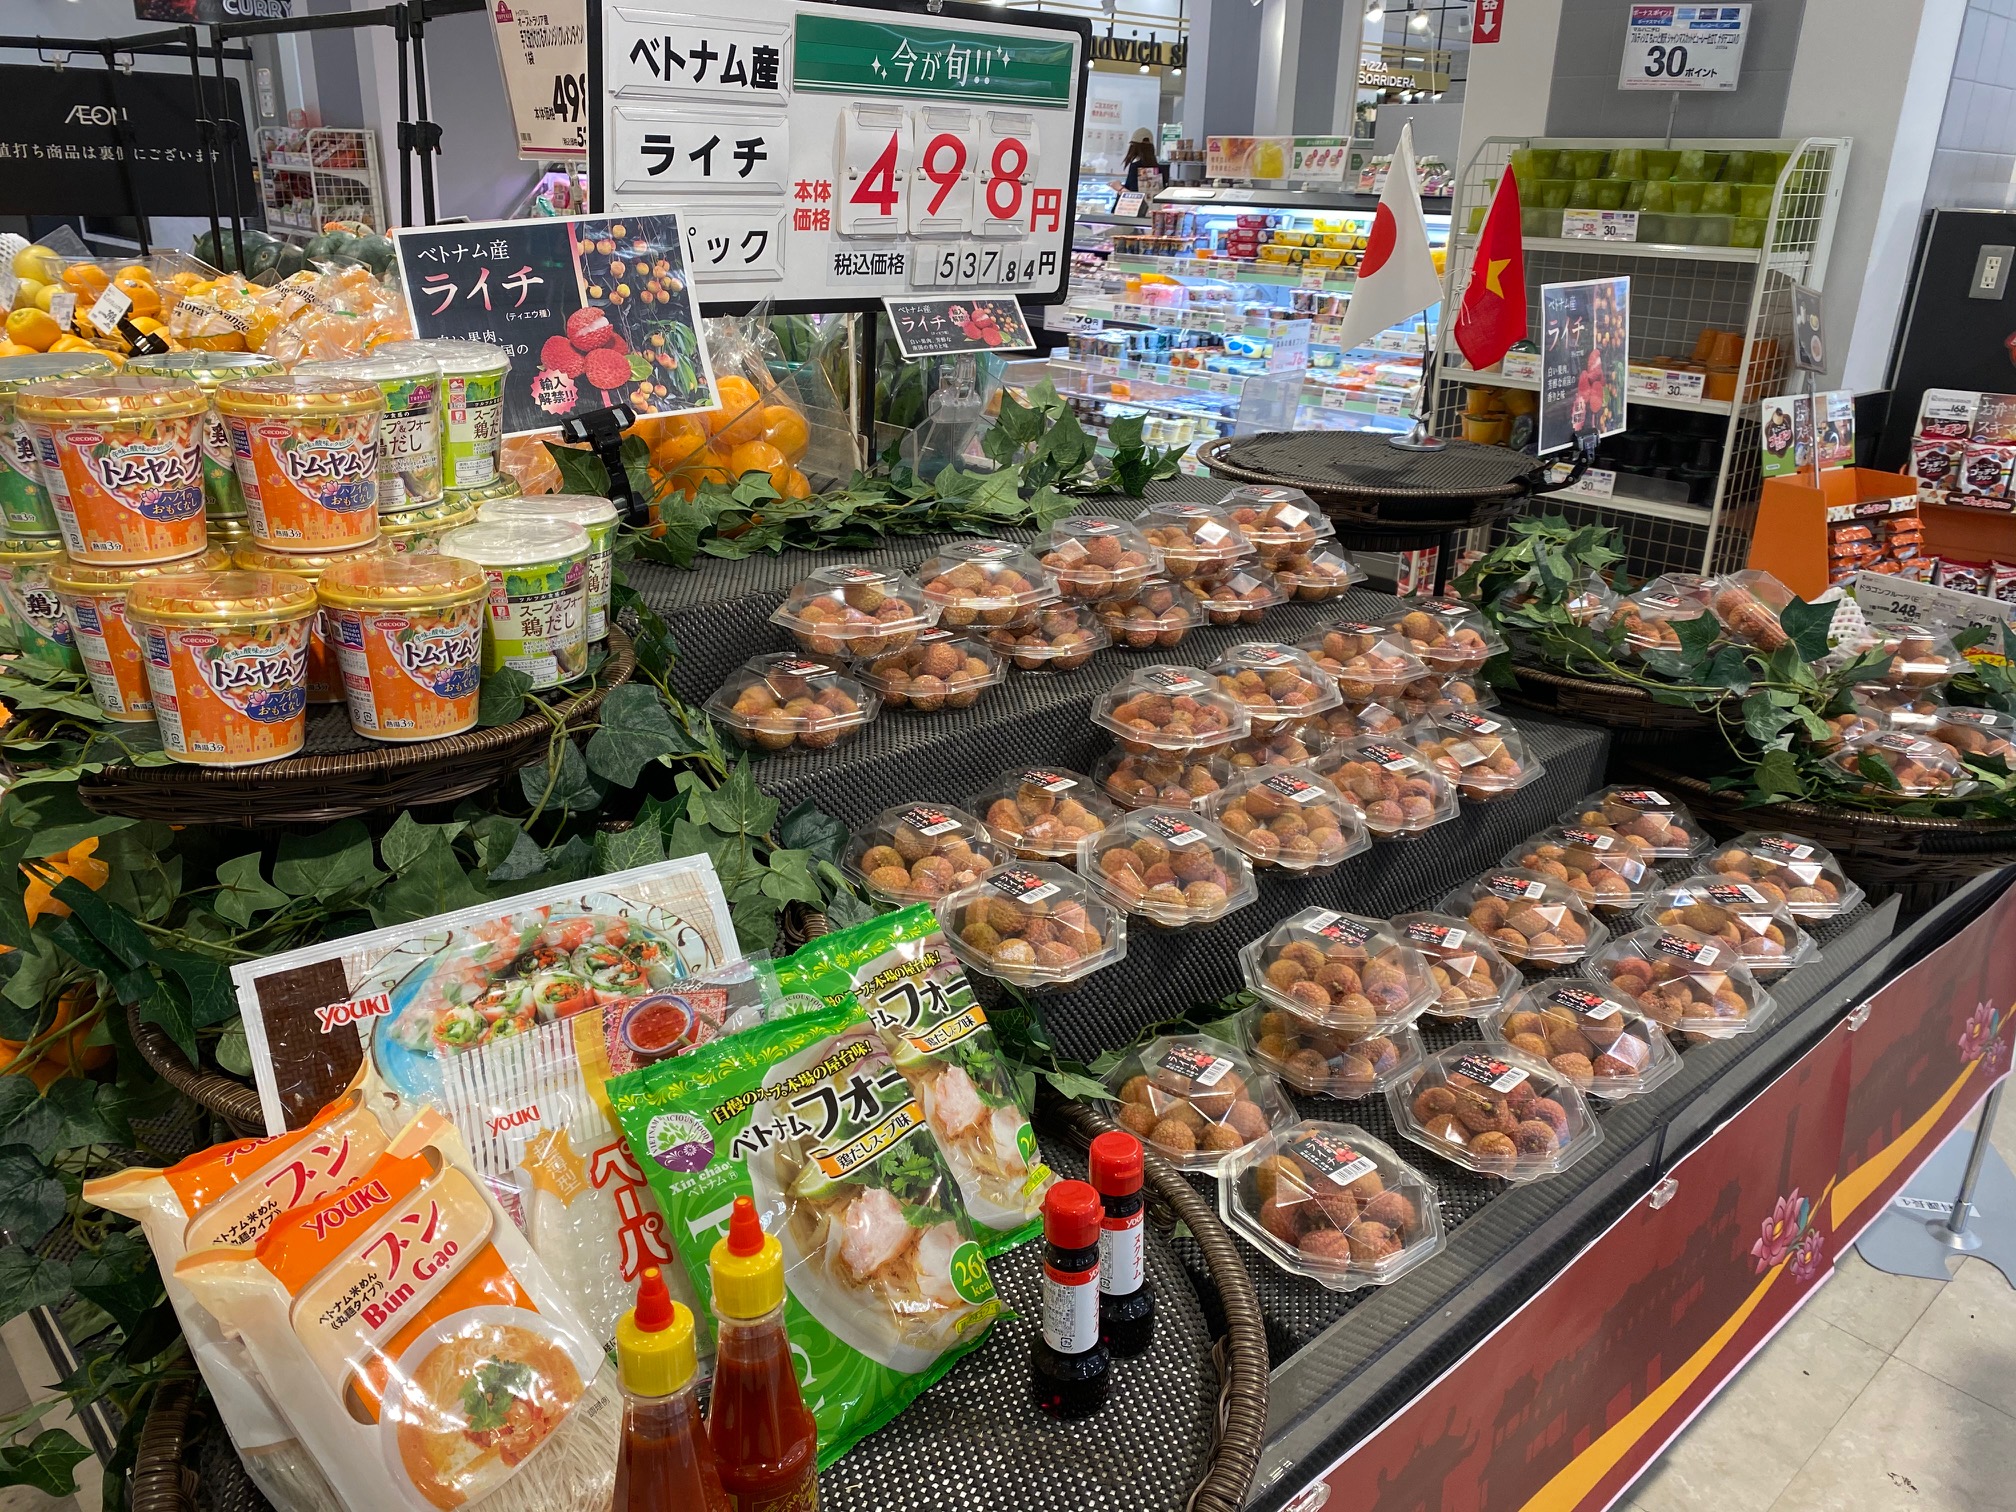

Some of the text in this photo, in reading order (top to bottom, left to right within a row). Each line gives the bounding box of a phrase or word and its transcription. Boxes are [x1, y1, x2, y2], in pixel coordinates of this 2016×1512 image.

[222, 0, 293, 17] CURRY
[629, 35, 779, 90] ベトナム産
[1360, 59, 1388, 72] PIZZA
[1644, 45, 1717, 78] 30 ポイント
[577, 127, 586, 147] 5
[640, 134, 768, 179] ライチ
[794, 180, 832, 203] 本体
[793, 208, 831, 232] 価格
[1604, 225, 1616, 236] 30
[418, 239, 510, 264] ベトナム産
[834, 253, 905, 276] 税込価格
[421, 265, 544, 316] ライチ
[898, 305, 932, 314] ベトナム産
[1548, 296, 1576, 311] ベトナム産
[901, 315, 946, 333] ライチ
[1548, 316, 1585, 351] ライチ
[539, 376, 566, 389] 輸入
[1667, 385, 1680, 396] 30
[538, 391, 575, 406] 解禁!!
[1581, 481, 1593, 491] 30
[152, 498, 197, 515] おもてなし
[331, 490, 372, 506] おもてなし
[520, 596, 583, 617] スープ&フォー
[521, 612, 575, 637] 鶏だし
[259, 699, 300, 716] おもてなし
[386, 720, 414, 728] 熱湯3分
[194, 743, 224, 752] 熱湯3分
[316, 993, 391, 1031] YOUKI
[1461, 1061, 1493, 1078] ライチ
[485, 1105, 542, 1138] YOUKI
[223, 1132, 285, 1166] YOU
[836, 1112, 913, 1170] 鶏だしスープ味
[1305, 1142, 1335, 1166] ライチ
[265, 1135, 349, 1209] ブン
[668, 1178, 697, 1196] Xin
[688, 1176, 727, 1198] ベトナム
[300, 1179, 391, 1242] YOUKI
[1126, 1213, 1143, 1229] YOUK
[361, 1200, 438, 1281] ブン
[319, 1272, 378, 1325] ベトナム米めん
